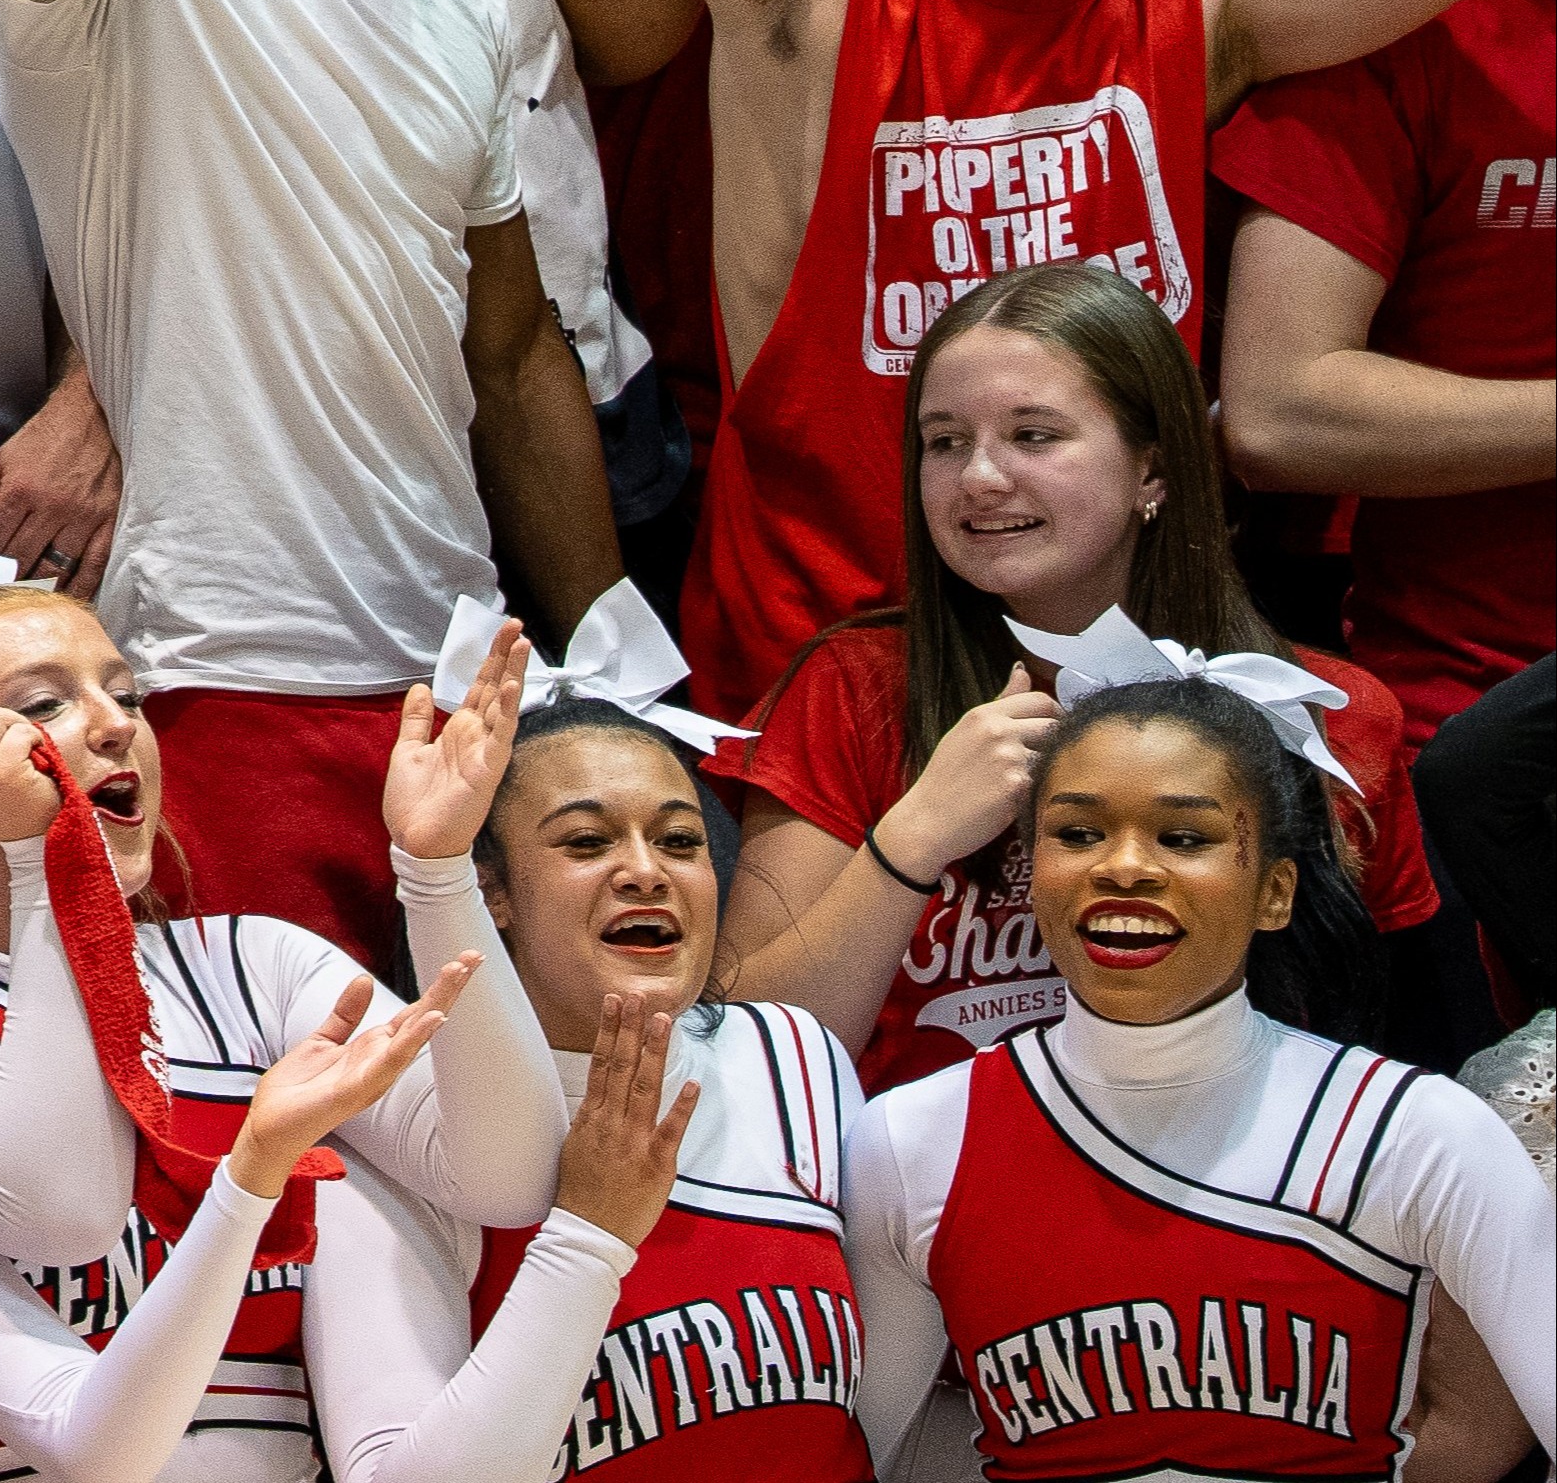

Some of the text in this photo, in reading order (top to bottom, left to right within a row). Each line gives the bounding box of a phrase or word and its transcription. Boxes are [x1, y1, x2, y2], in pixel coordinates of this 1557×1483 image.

[932, 202, 1078, 273] O THE
[958, 989, 1046, 1026] ANNIES
[976, 1299, 1354, 1443] CENTRALIA
